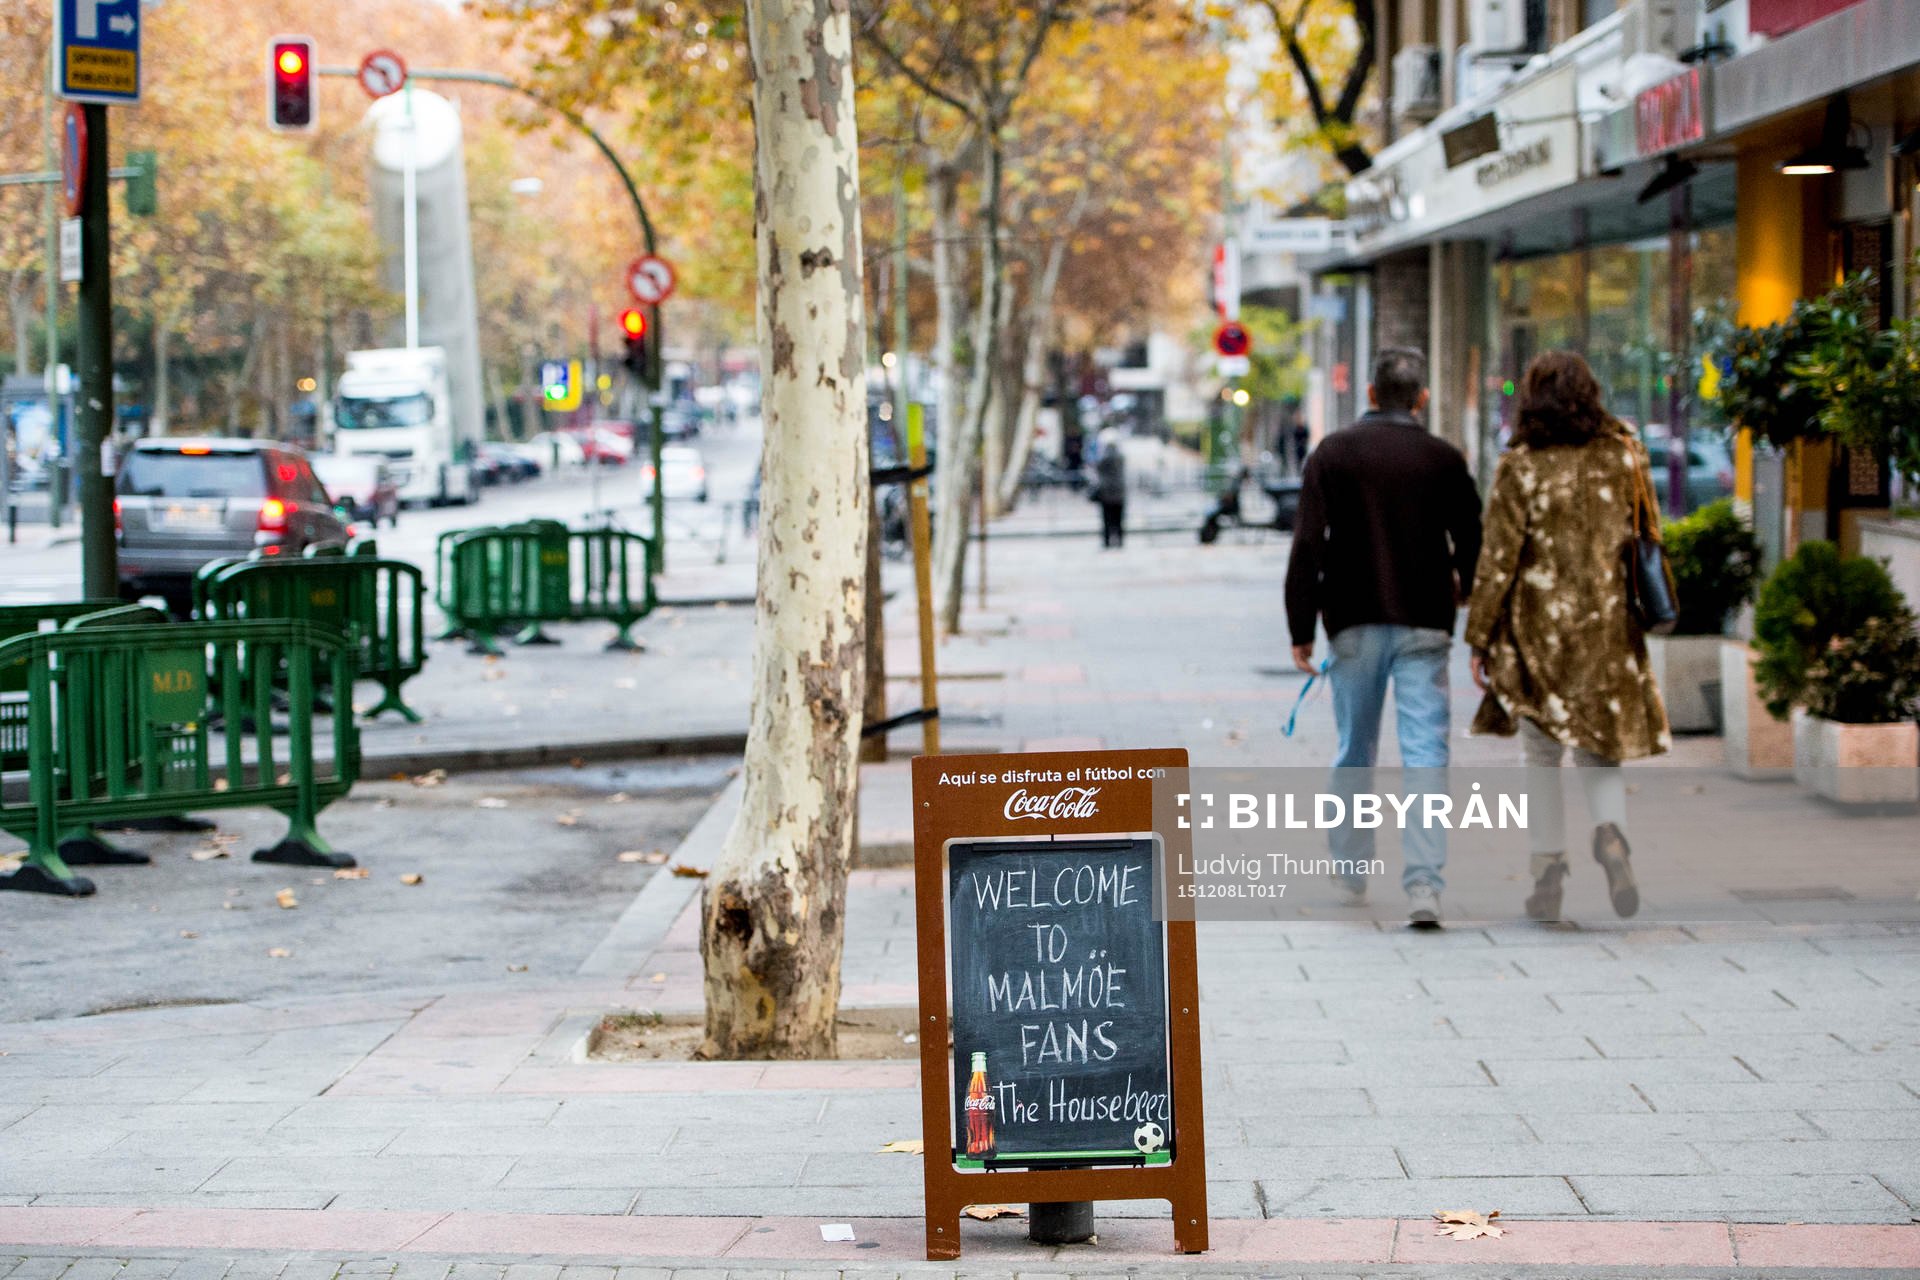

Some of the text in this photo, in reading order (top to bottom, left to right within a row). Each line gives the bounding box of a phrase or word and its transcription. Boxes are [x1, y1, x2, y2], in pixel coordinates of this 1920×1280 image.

[939, 766, 1166, 787] Aquí se disfruta el fútbol con
[1003, 786, 1102, 821] Coca-Cola
[972, 864, 1142, 911] WELCOME
[1027, 923, 1068, 963] TO
[987, 948, 1127, 1012] MALMÖE
[1020, 1019, 1119, 1066] FANS
[992, 1073, 1170, 1124] The Housebeer
